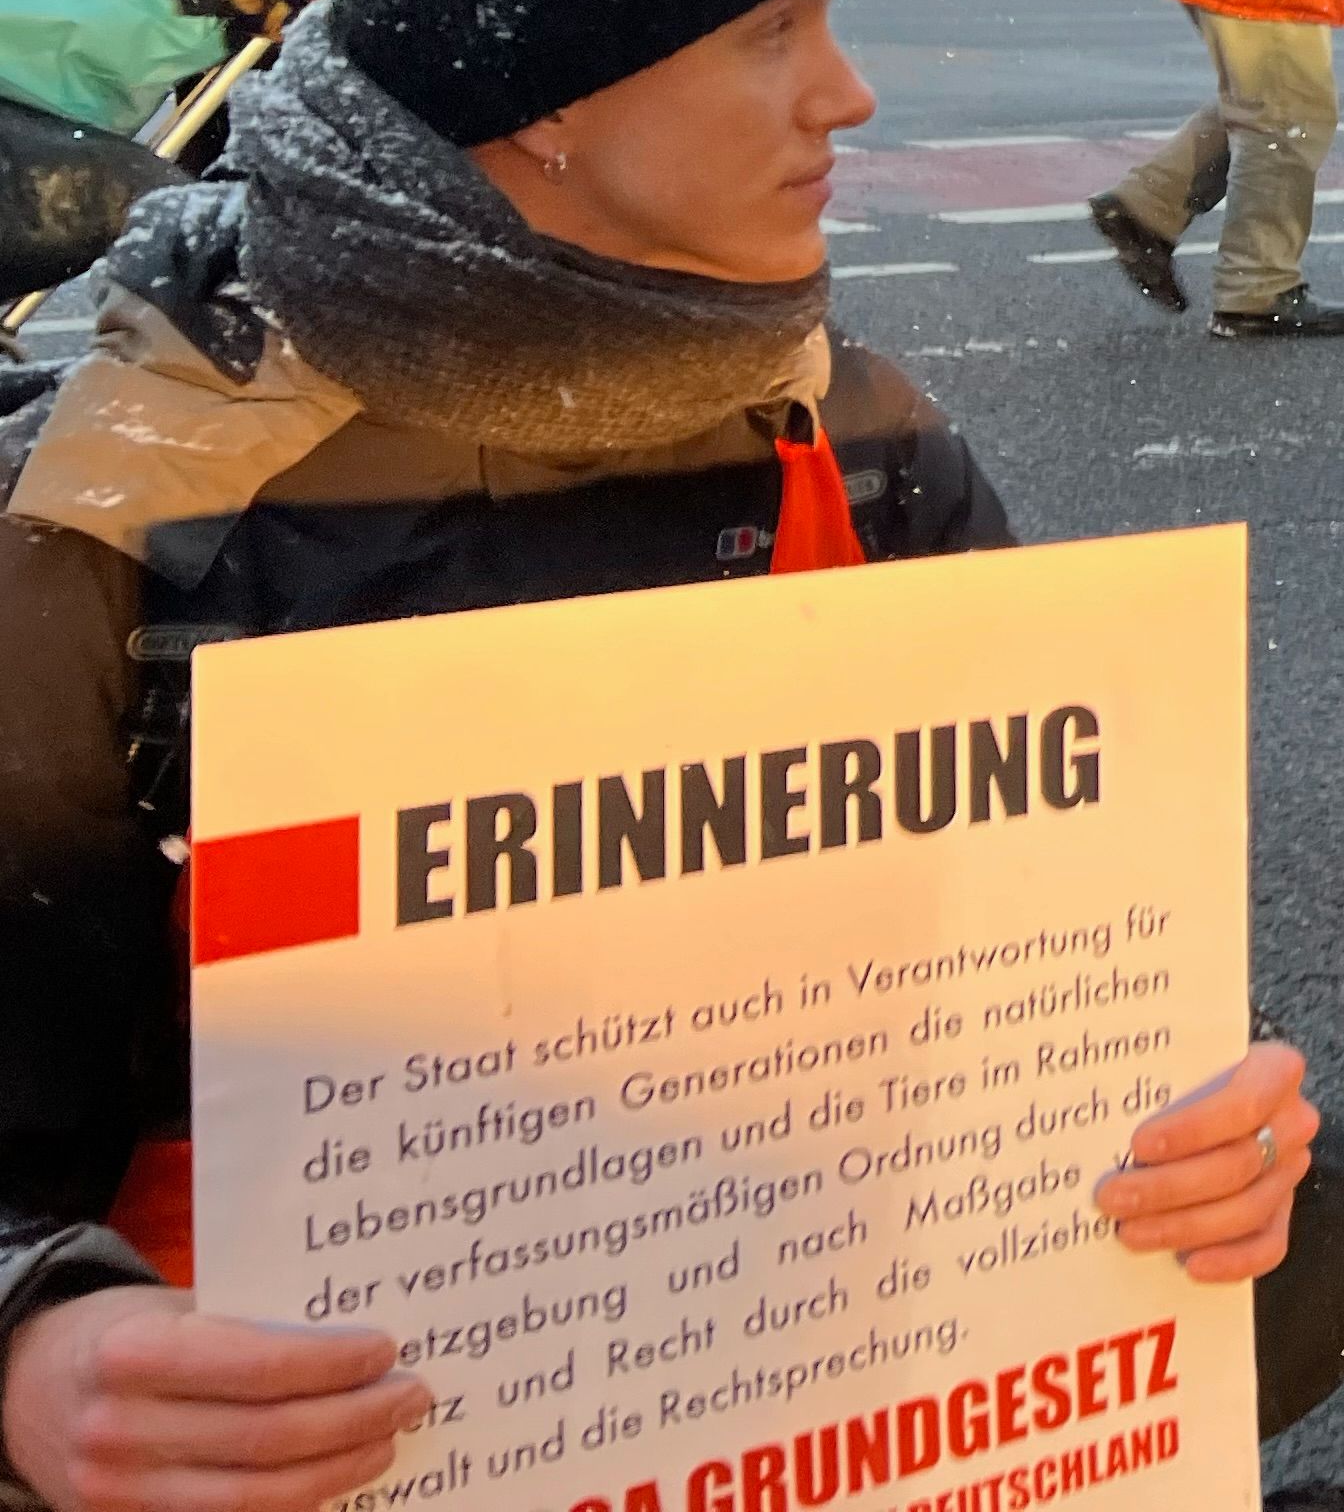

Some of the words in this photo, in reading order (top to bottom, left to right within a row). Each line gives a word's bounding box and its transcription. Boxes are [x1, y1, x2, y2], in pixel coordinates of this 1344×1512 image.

[395, 705, 1100, 926] ERINNERUNG
[304, 1073, 385, 1115] Der
[404, 1040, 518, 1092] Staat
[533, 1017, 676, 1066] schützt
[691, 978, 783, 1031] auch
[799, 973, 831, 1009] in
[848, 924, 1111, 996] Verantwortung
[1126, 904, 1172, 944] für
[304, 1139, 371, 1184] die
[399, 1095, 595, 1164] künftigen
[620, 1029, 888, 1109] Generationen
[909, 1007, 963, 1046] die
[983, 966, 1170, 1030] natürlichen
[304, 1277, 382, 1321] der
[397, 1167, 823, 1295] verfassungsmäßigen
[839, 1123, 1001, 1185] Ordnung
[1016, 1088, 1109, 1141] durch
[1122, 1076, 1172, 1116] die
[305, 1135, 703, 1252] Lebensgrundlagen
[721, 1100, 791, 1152] und
[809, 1090, 865, 1131] die
[879, 1074, 967, 1113] Tiere
[982, 1056, 1020, 1090] im
[1036, 1025, 1171, 1077] Rahmen
[398, 1284, 628, 1366] etzgebung
[668, 1239, 740, 1293] und
[778, 1211, 868, 1265] nach
[904, 1163, 1082, 1232] Maßgabe
[497, 1348, 576, 1409] und
[607, 1317, 715, 1377] Recht
[743, 1278, 848, 1337] durch
[877, 1258, 931, 1300] die
[487, 1417, 565, 1478] und
[581, 1404, 643, 1451] die
[660, 1315, 969, 1428] Rechtsprechung.
[687, 1317, 1179, 1512] GRUNDGESETZ
